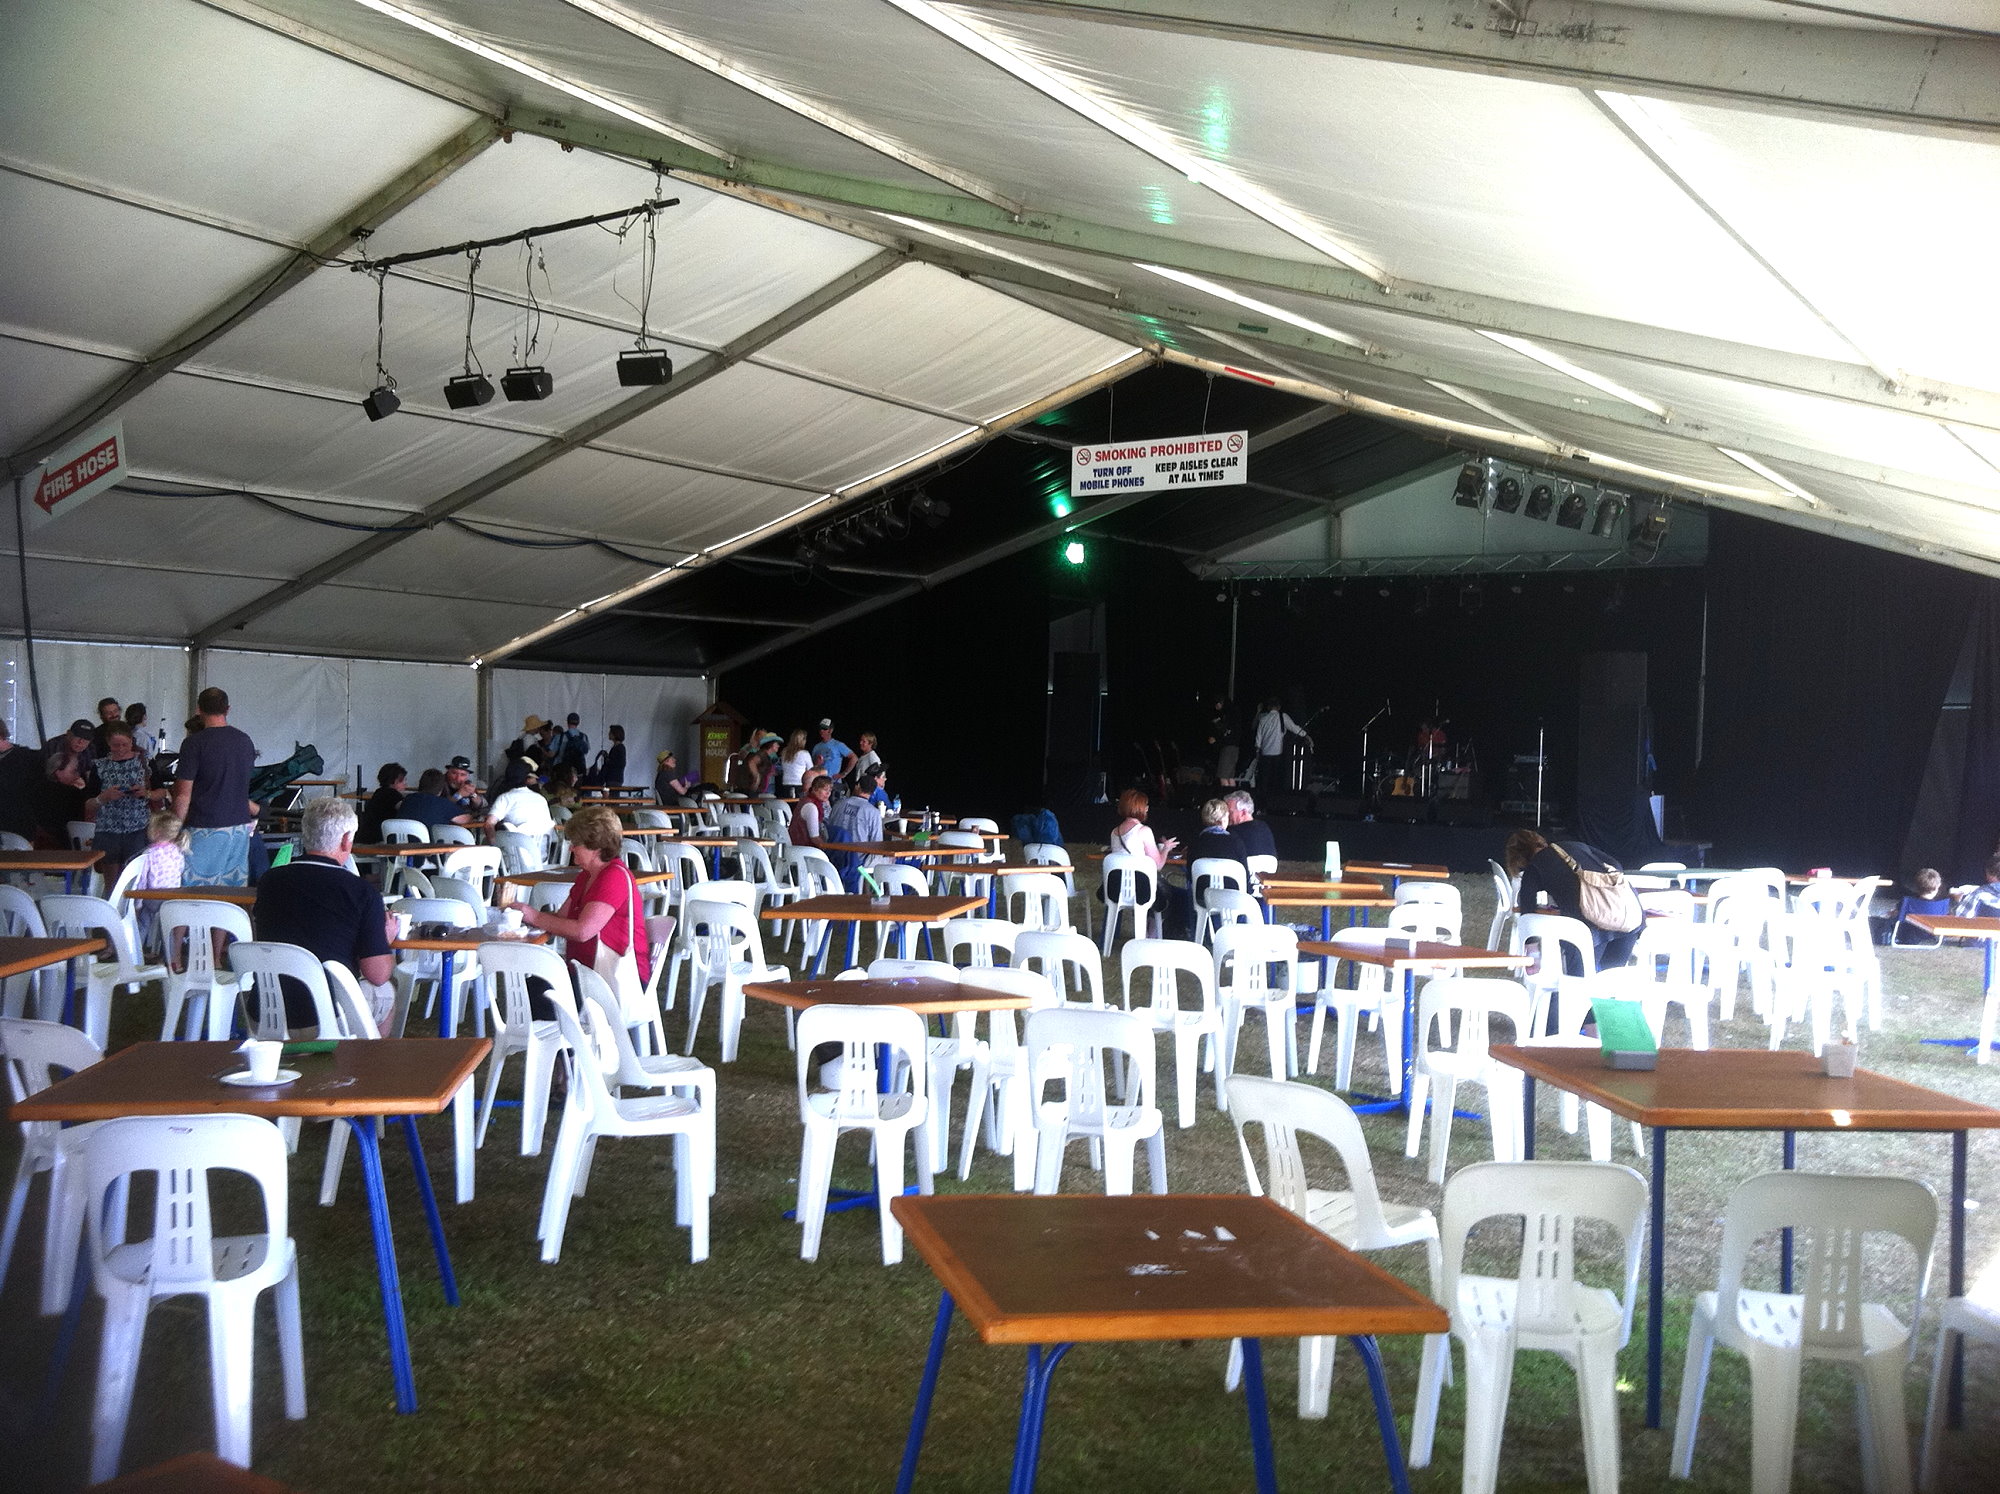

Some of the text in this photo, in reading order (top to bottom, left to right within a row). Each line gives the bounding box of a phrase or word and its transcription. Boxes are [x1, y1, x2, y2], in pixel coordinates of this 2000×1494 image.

[1095, 439, 1223, 462] SMOKING PROHIBITED
[1093, 466, 1132, 478] TURN OFF
[1155, 456, 1239, 473] KEEP AISLES CLEAR
[43, 444, 116, 503] FIRE HOSE
[1168, 470, 1225, 484] AT ALL TIMES
[1079, 477, 1145, 490] MOBILE PHONES
